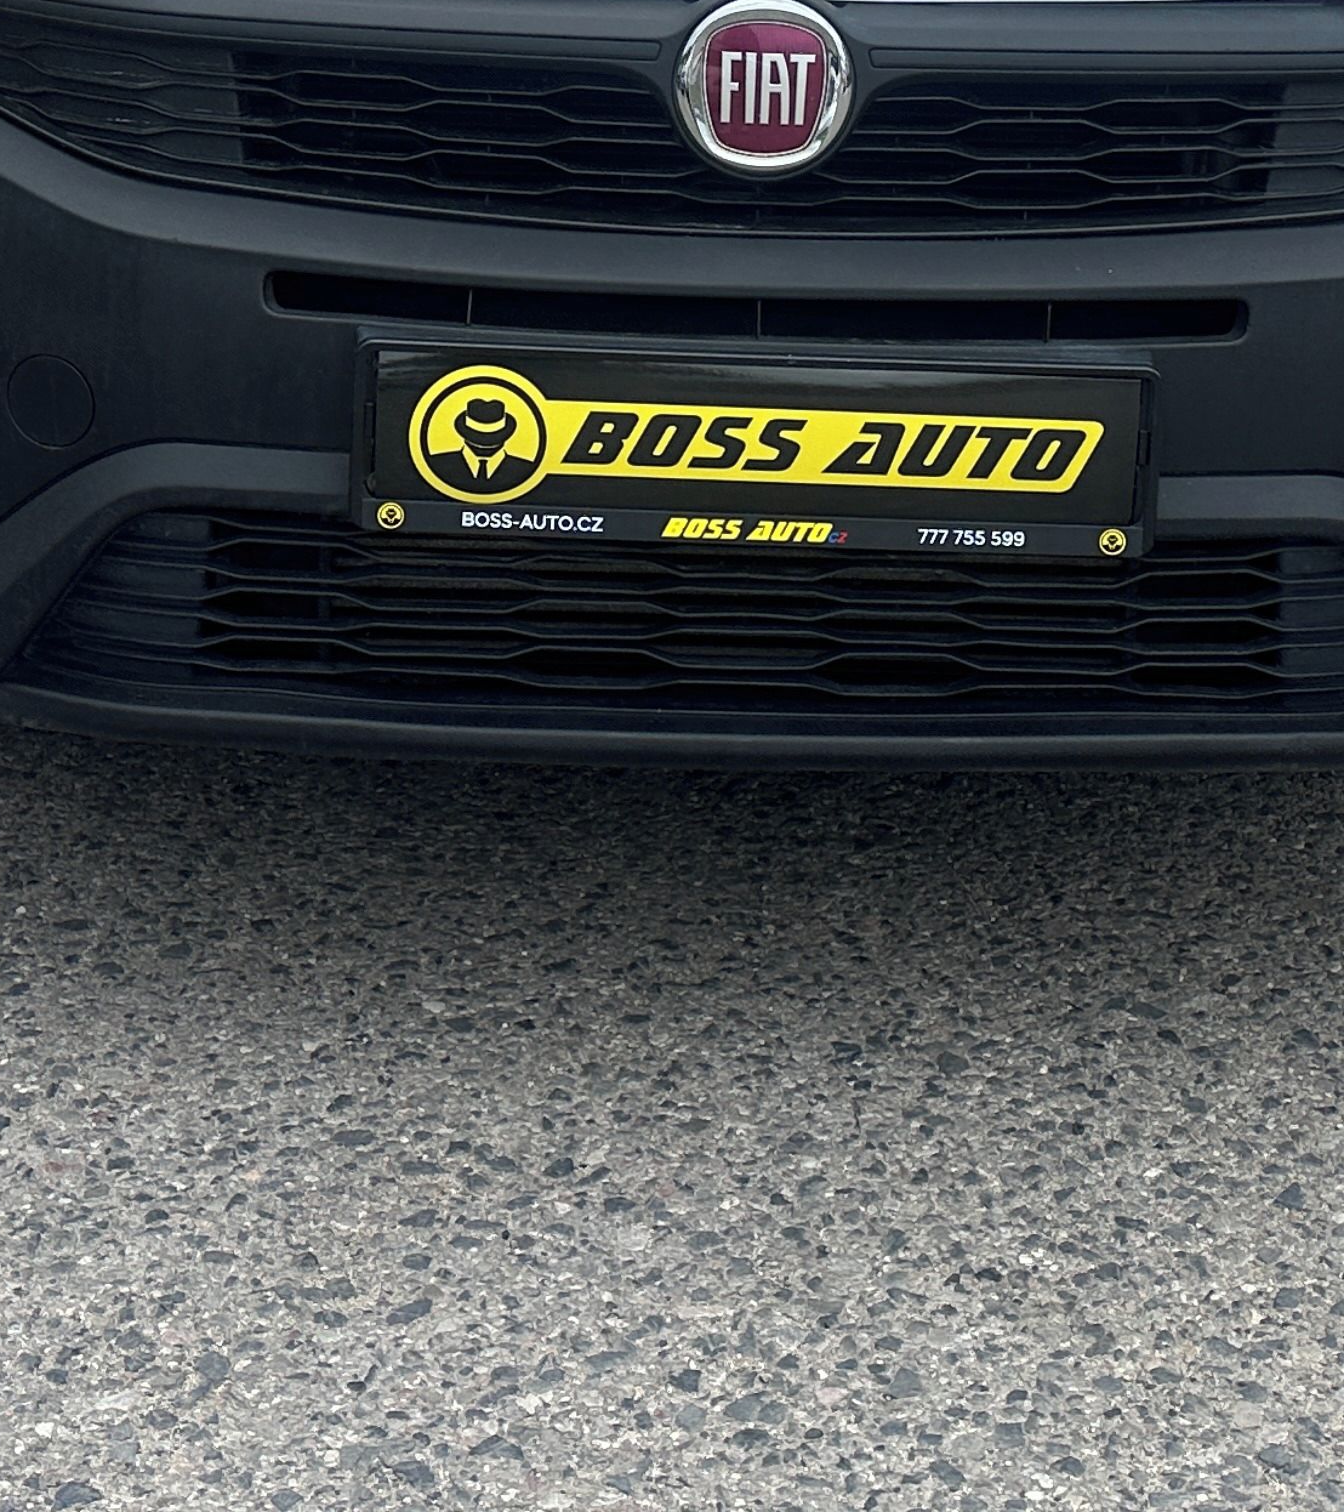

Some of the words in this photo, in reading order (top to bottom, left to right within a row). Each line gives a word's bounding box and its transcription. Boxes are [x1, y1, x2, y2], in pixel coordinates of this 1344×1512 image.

[720, 50, 816, 126] FIAT
[560, 411, 809, 473] BOSS
[821, 420, 1085, 482] AUTO
[461, 511, 604, 533] BOSS-AUTO.CZ
[661, 517, 743, 540] BOSS
[917, 528, 949, 545] 777
[953, 529, 986, 546] 755
[990, 530, 1025, 547] 599
